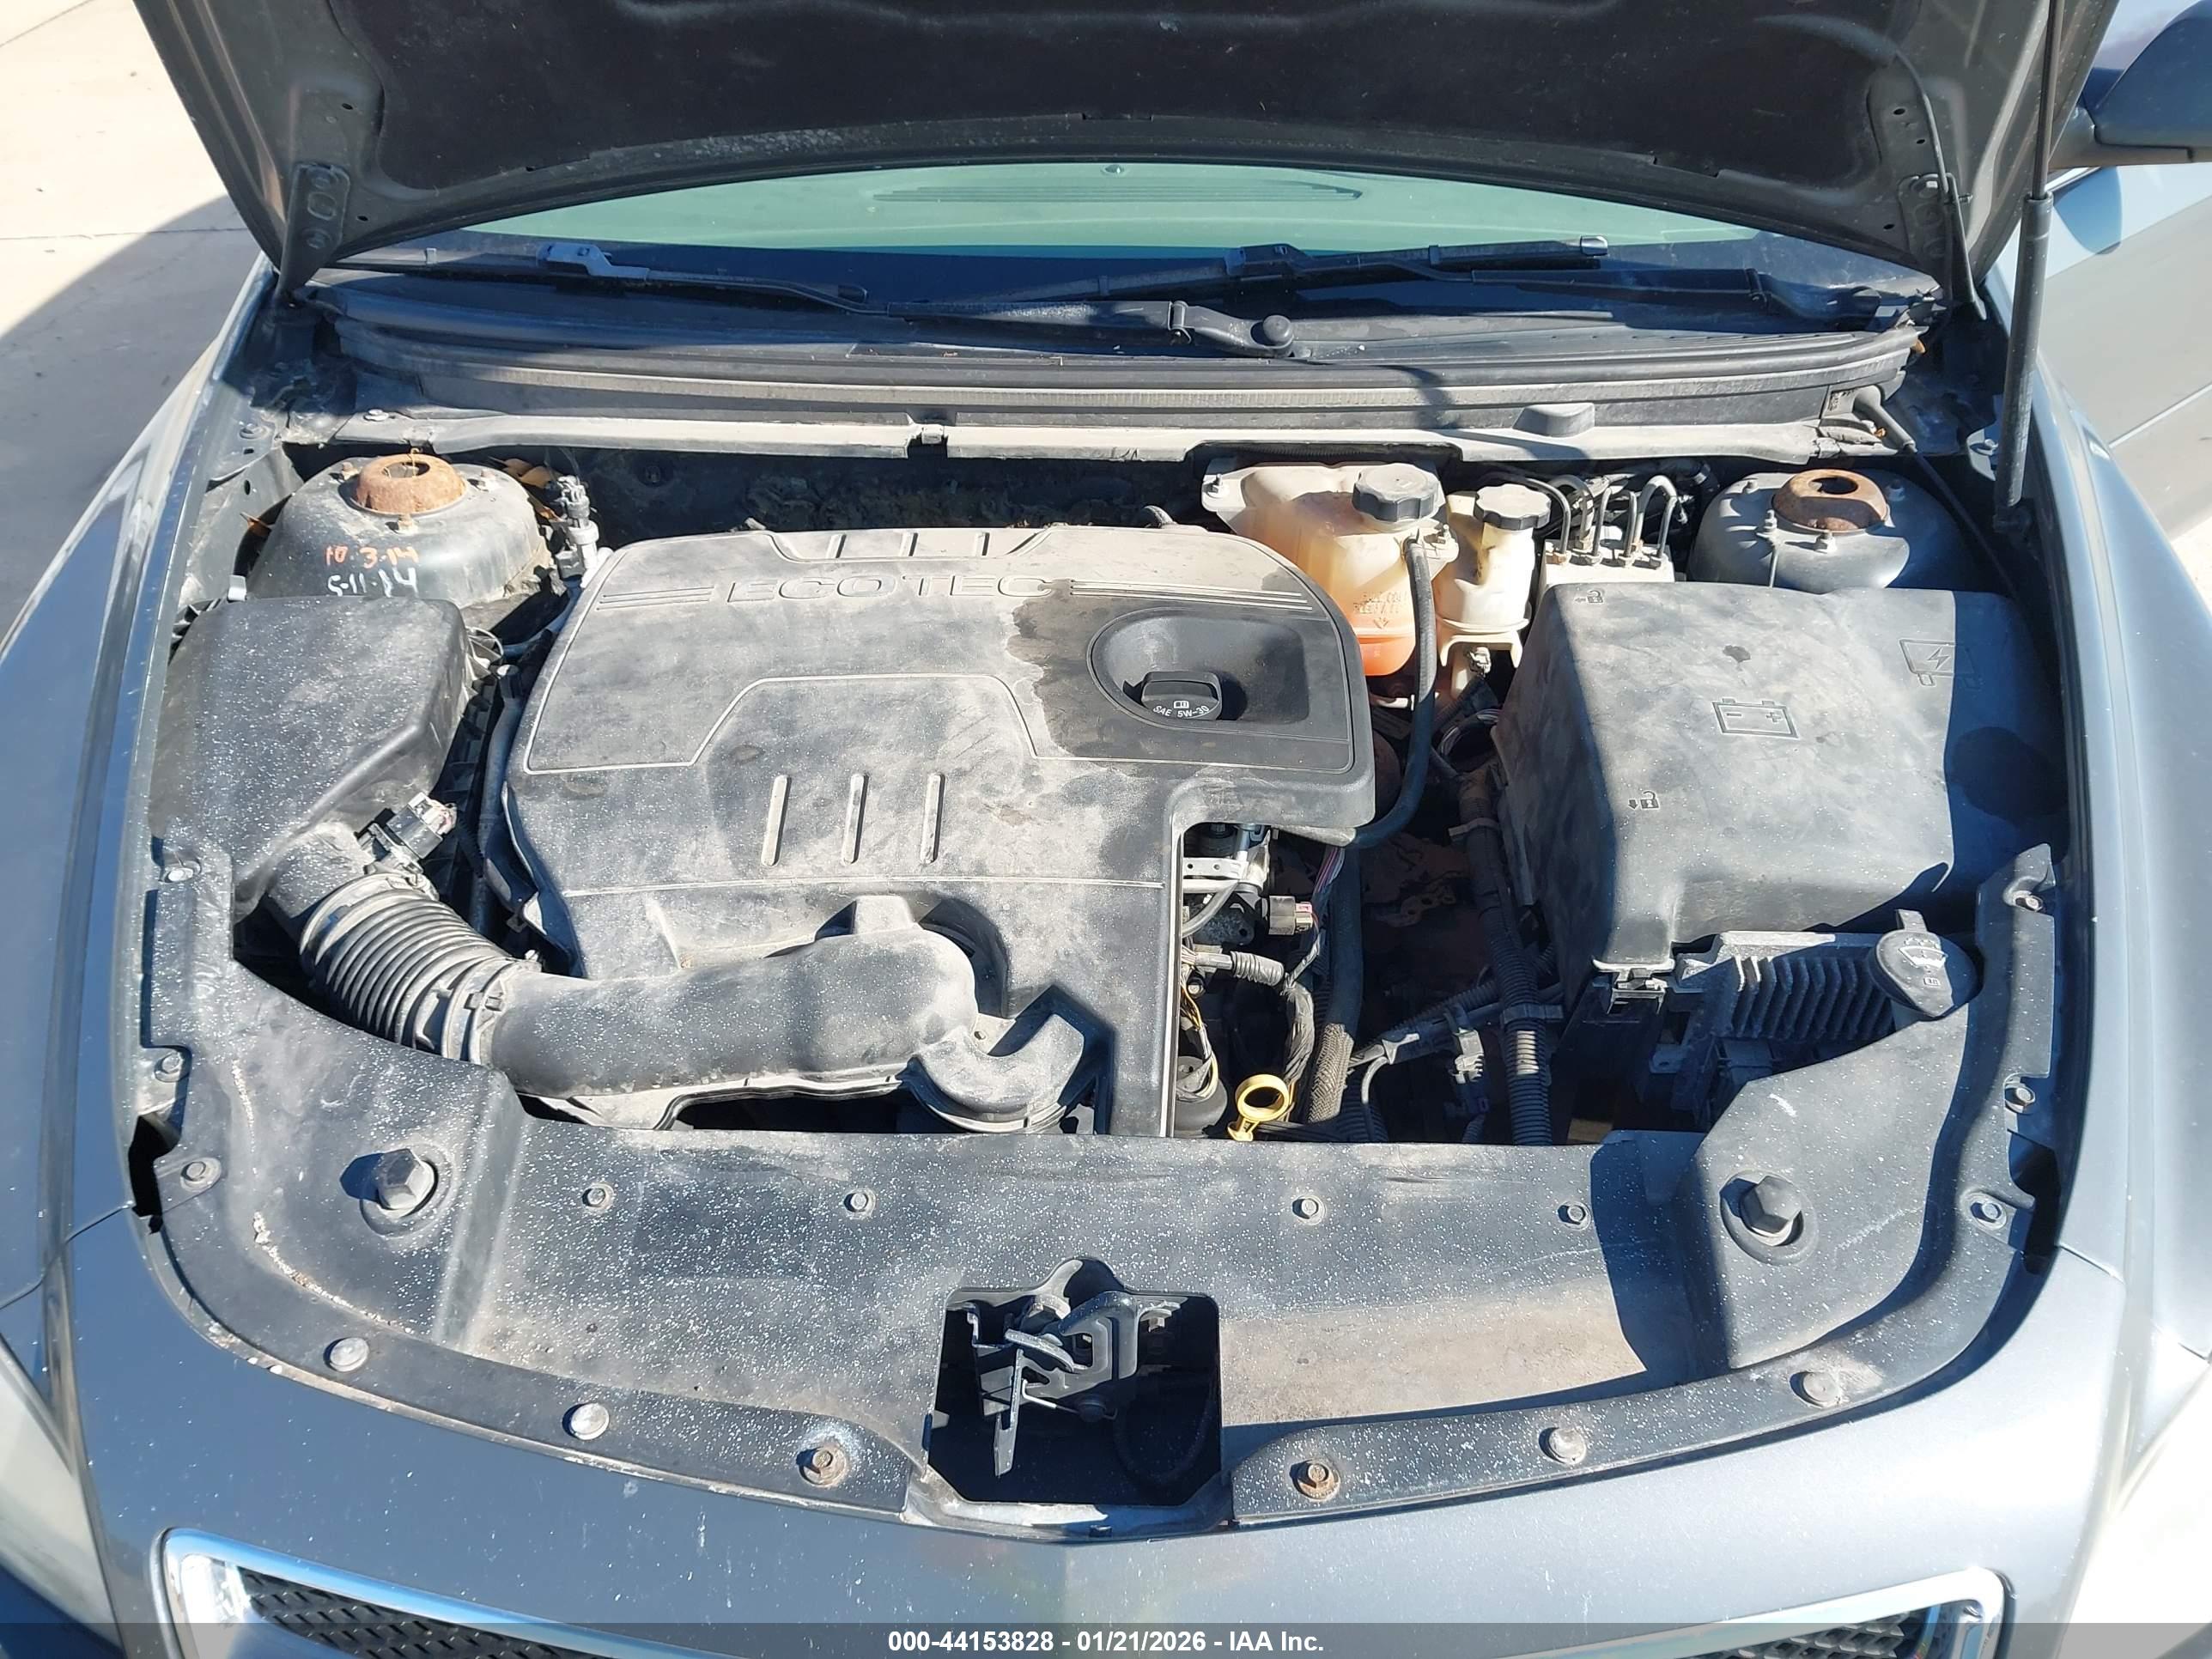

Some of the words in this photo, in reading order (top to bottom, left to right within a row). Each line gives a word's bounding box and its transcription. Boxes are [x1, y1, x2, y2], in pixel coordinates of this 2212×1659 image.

[726, 574, 1054, 603] ECOTEC
[1152, 705, 1173, 717] SAE
[1176, 705, 1210, 718] 5W-30
